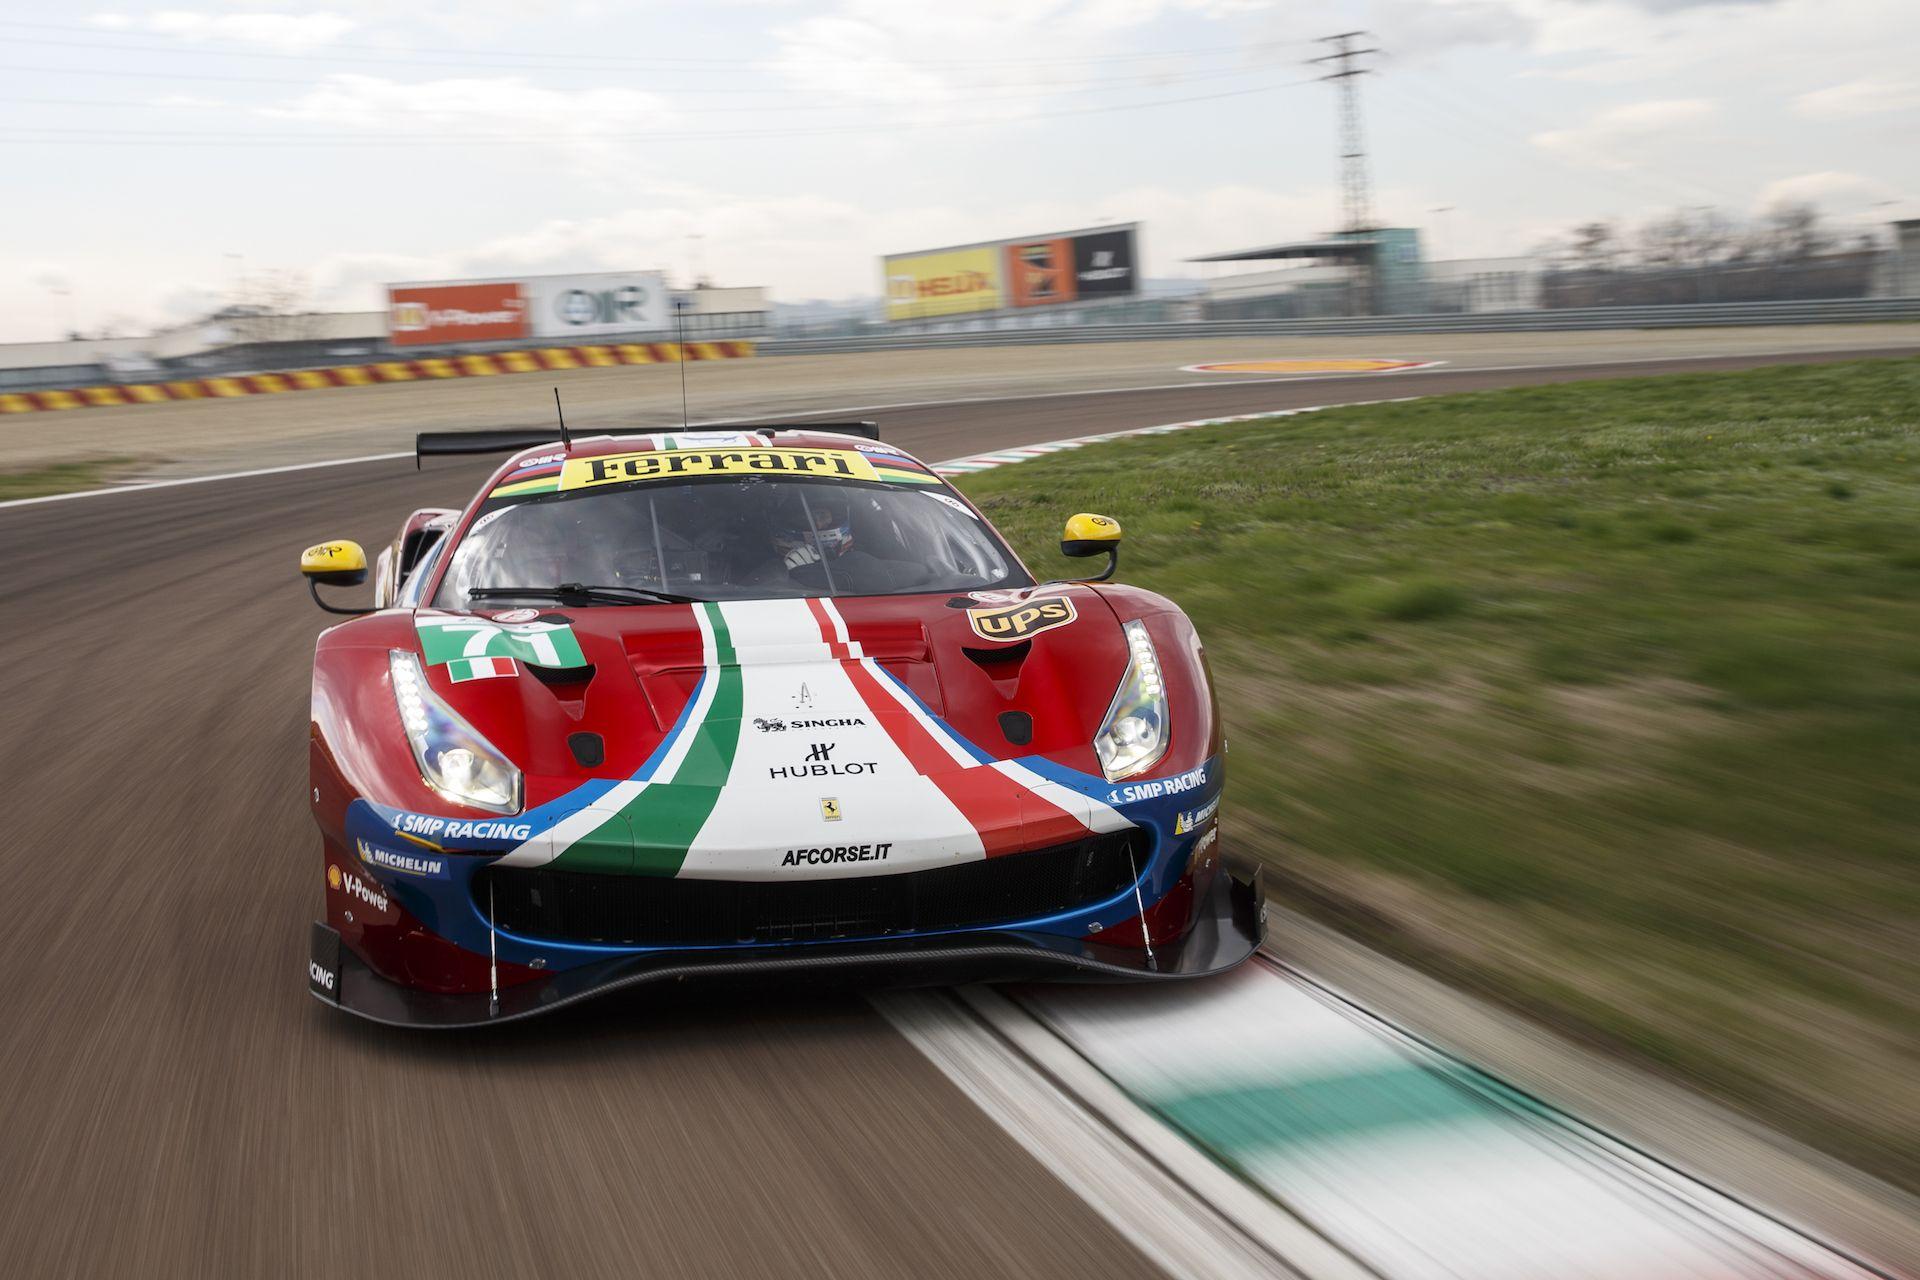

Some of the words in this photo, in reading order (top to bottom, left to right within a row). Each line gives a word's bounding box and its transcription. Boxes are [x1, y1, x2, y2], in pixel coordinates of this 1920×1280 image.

[585, 451, 855, 483] Ferrari
[442, 624, 562, 666] 71
[791, 718, 866, 729] SINGHA
[770, 762, 878, 779] HUBLOT
[1123, 782, 1163, 802] SMP
[1163, 768, 1207, 795] RACING
[403, 814, 444, 836] SMP
[444, 822, 532, 840] RACING
[374, 849, 442, 874] MICHELIN
[781, 843, 892, 866] AFCORSE.IT
[343, 872, 389, 912] V-Power
